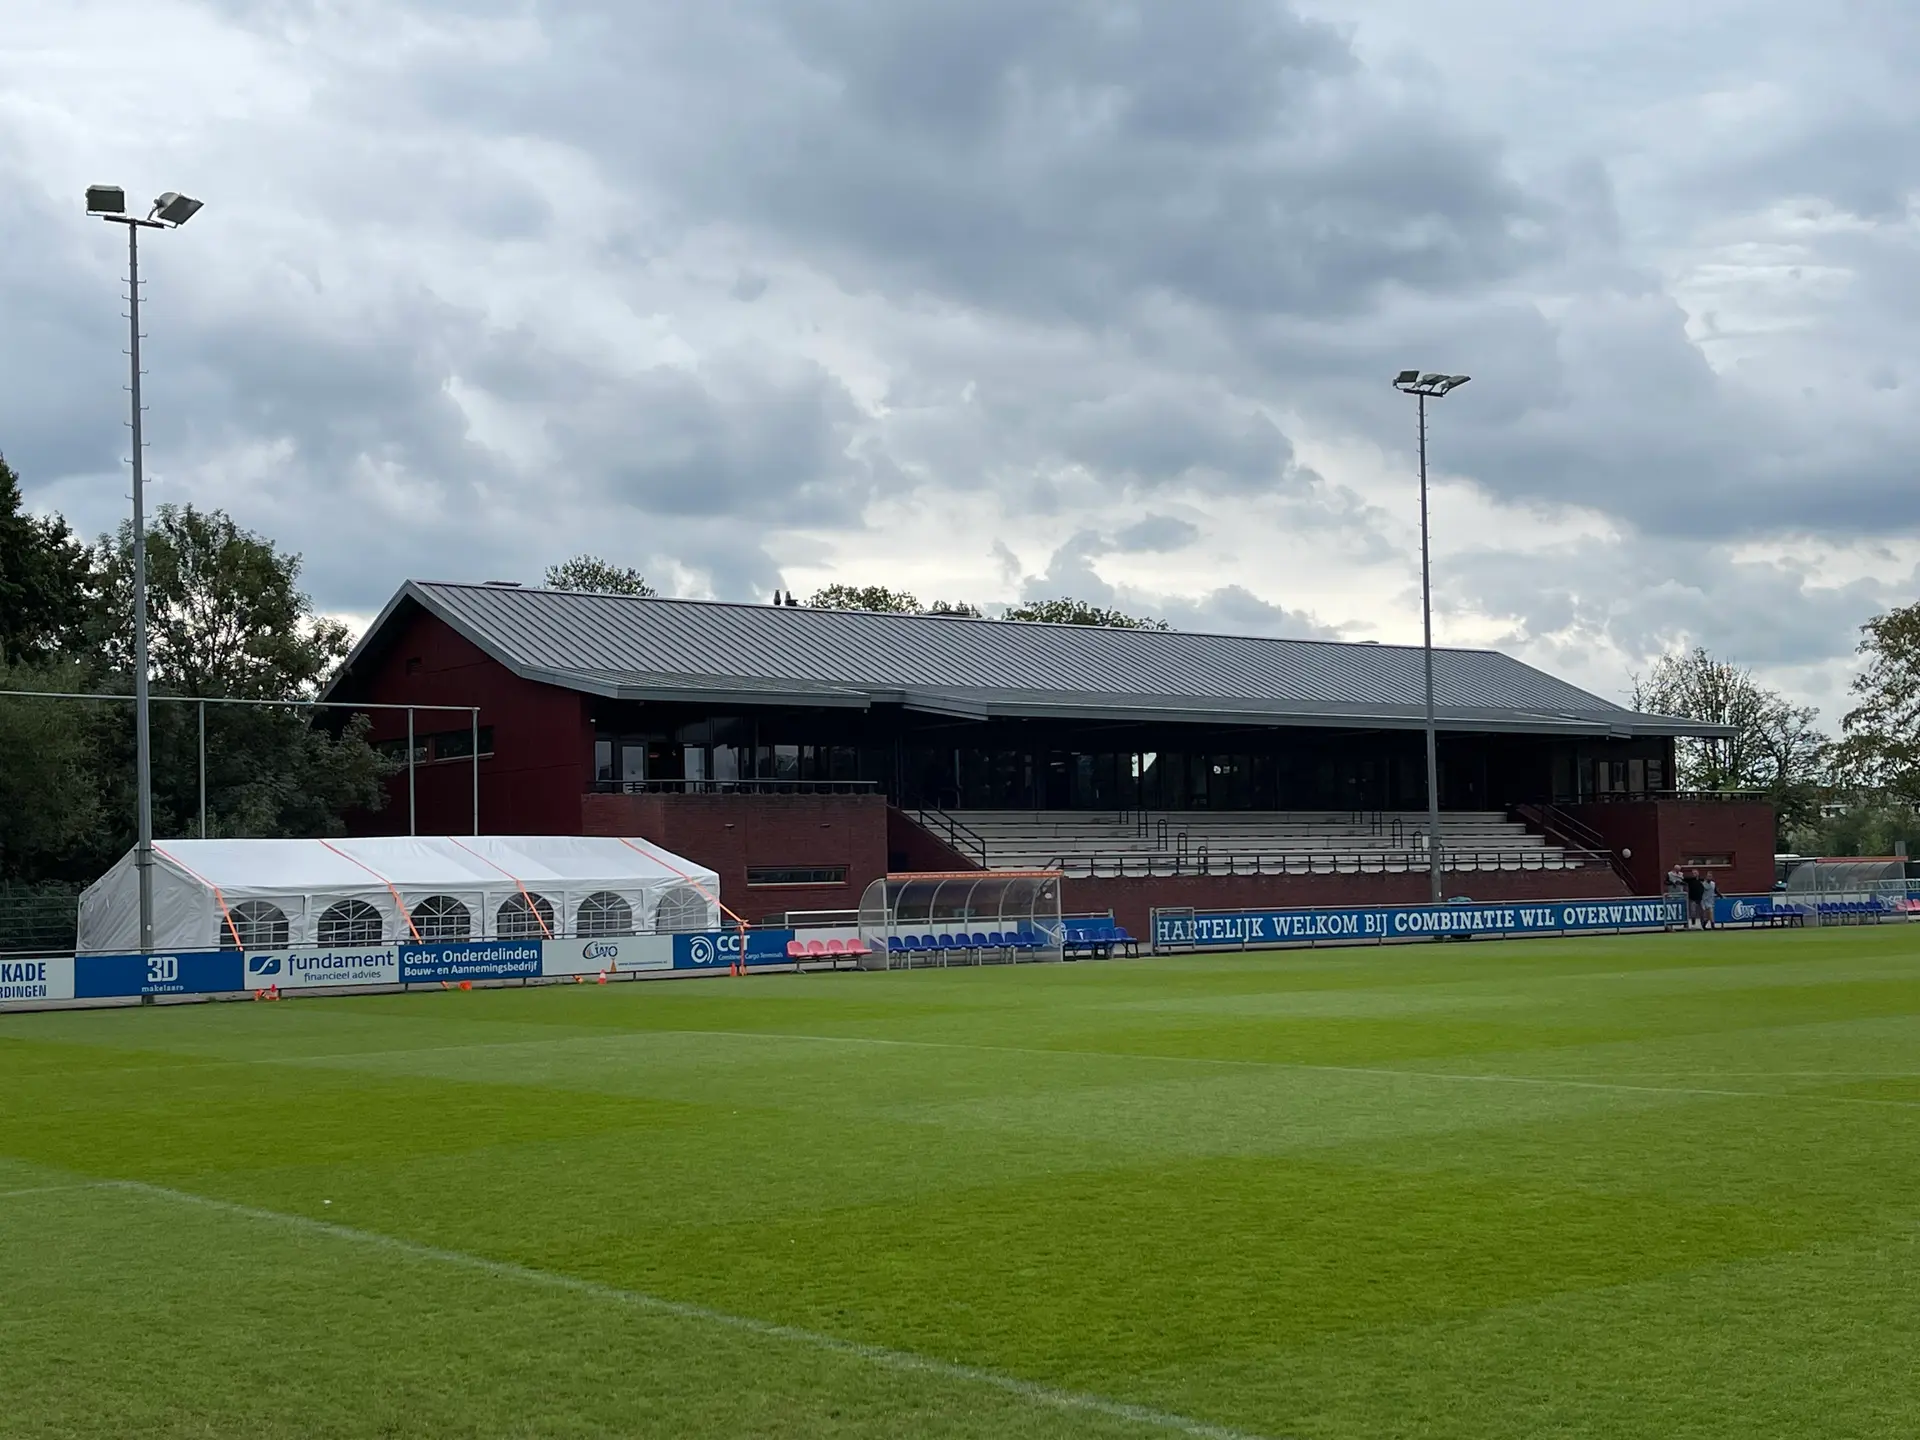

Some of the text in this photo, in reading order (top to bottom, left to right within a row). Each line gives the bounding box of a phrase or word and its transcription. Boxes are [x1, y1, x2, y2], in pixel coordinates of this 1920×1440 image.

[1158, 903, 1684, 942] HARTELIJK WELKOM BIJ COMBINATIE WIL OVERWINNEN!
[716, 935, 750, 952] CCT
[287, 950, 395, 976] fundament
[403, 947, 538, 965] Gebr. Onderdelinden
[1, 962, 47, 983] KADE
[147, 956, 178, 982] 3D
[304, 970, 382, 983] financieel advies
[404, 960, 538, 976] Bouw- en Aannemingsbedrijf
[141, 984, 184, 993] makelaars
